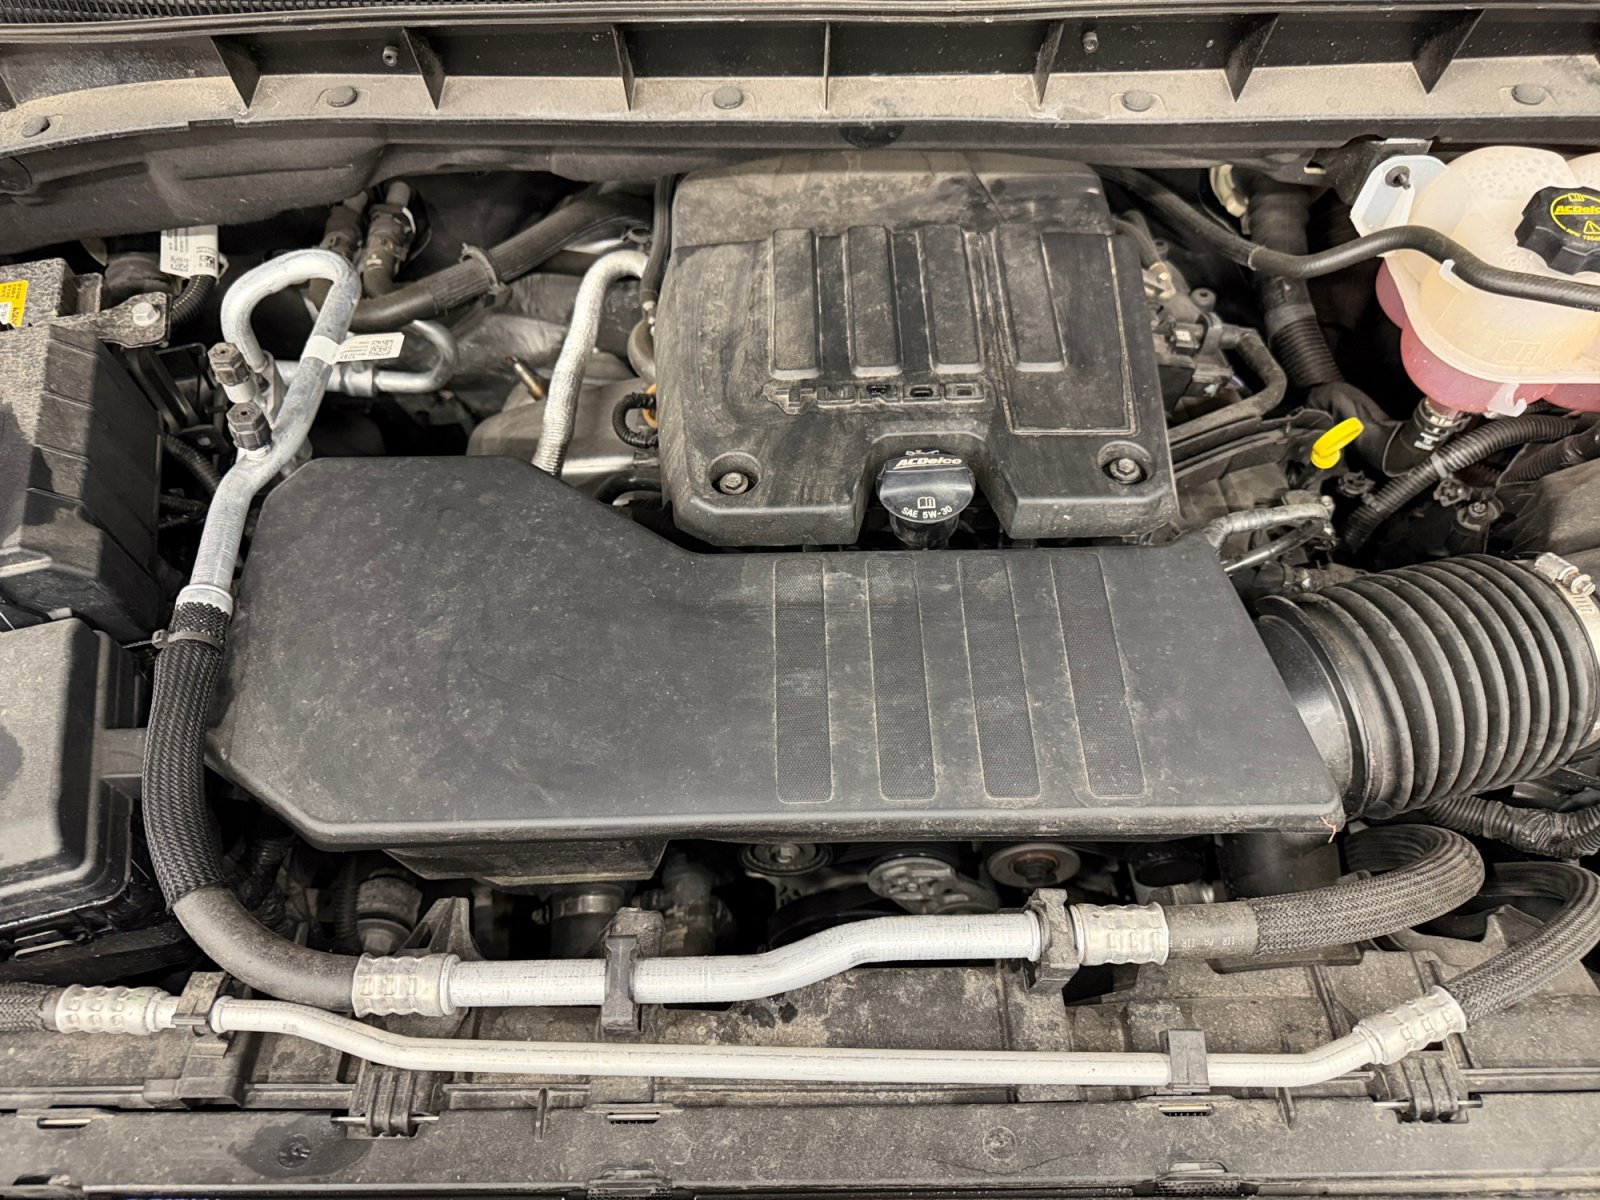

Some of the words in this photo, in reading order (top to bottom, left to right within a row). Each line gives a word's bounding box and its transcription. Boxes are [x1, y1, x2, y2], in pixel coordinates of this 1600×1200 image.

[1554, 205, 1600, 214] ACDelc
[895, 457, 962, 467] ACDelco
[901, 507, 919, 519] SAE
[922, 505, 953, 519] 5W-30
